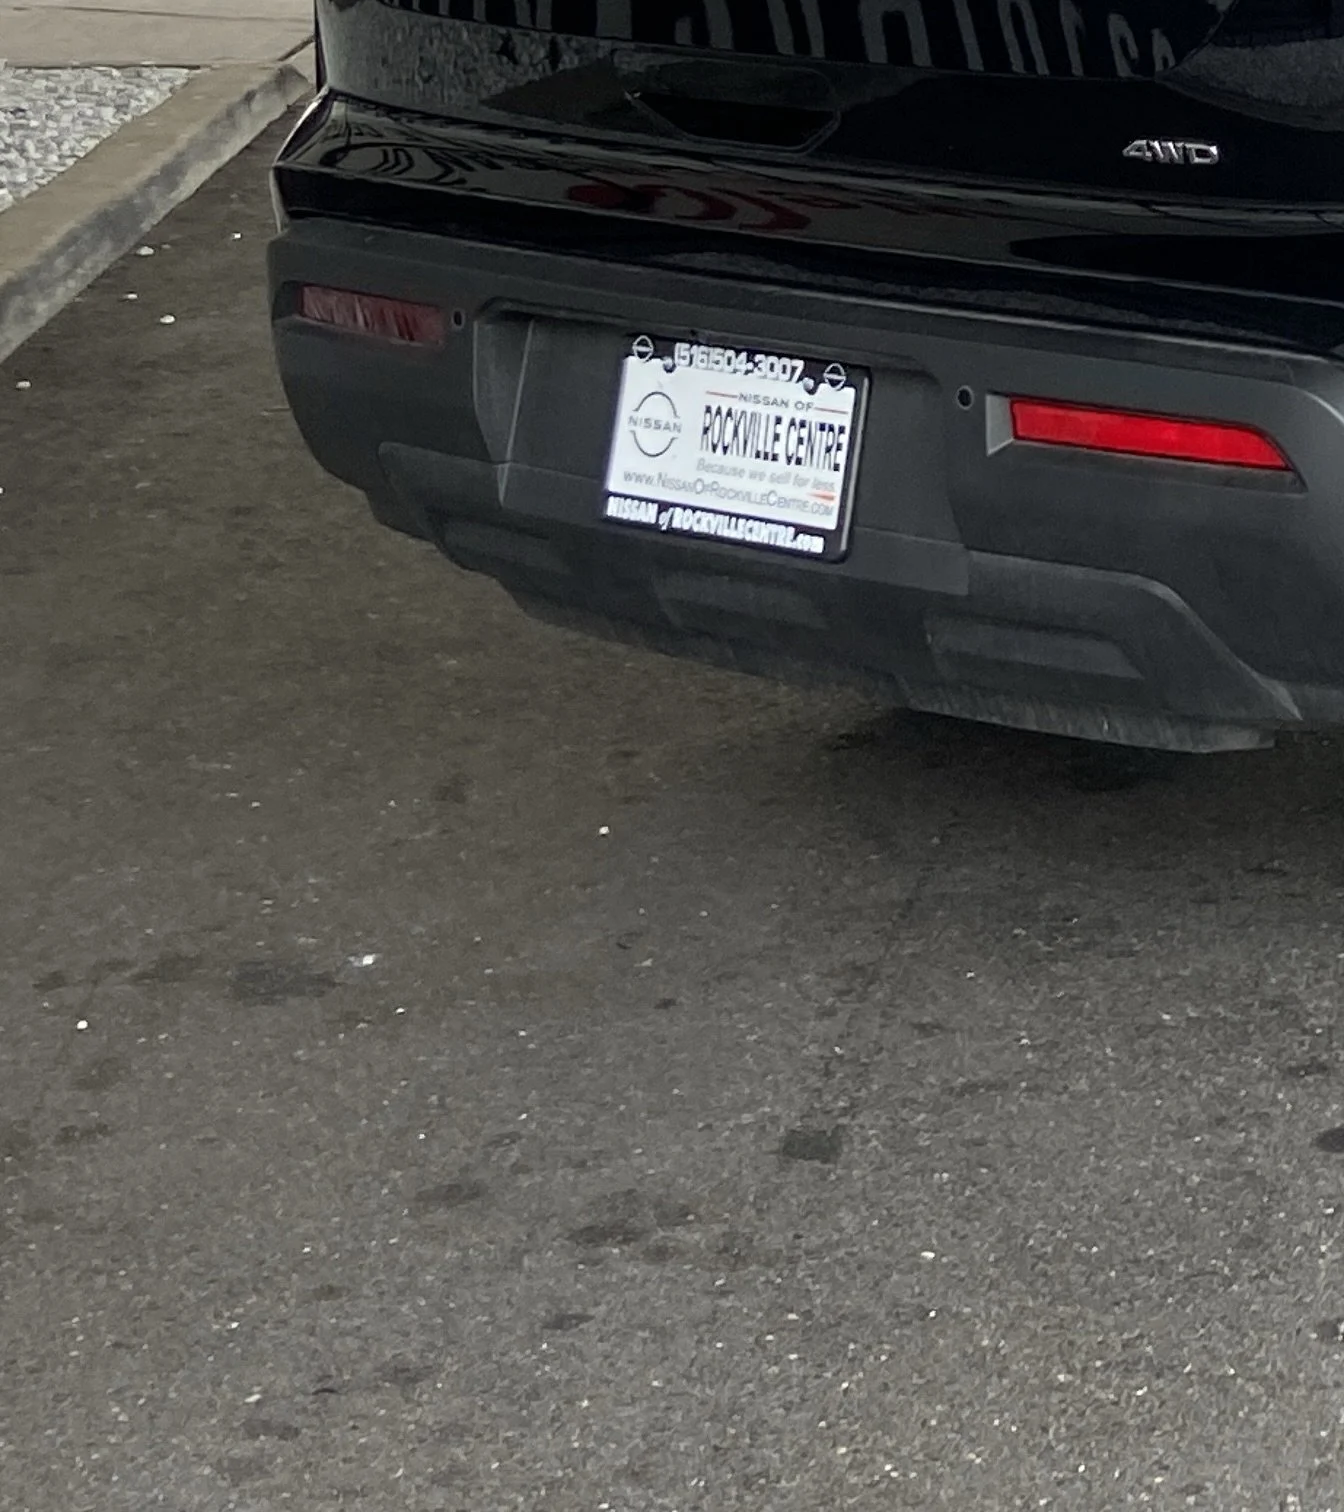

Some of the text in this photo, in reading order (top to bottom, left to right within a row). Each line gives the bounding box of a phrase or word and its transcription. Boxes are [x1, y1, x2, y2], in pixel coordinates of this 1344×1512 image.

[1122, 138, 1220, 166] 4WD
[737, 392, 815, 411] NISSAN OF
[627, 415, 683, 434] NISSAN
[700, 404, 847, 472] ROCKVILLE CENTRE
[696, 458, 746, 478] Because
[748, 468, 768, 481] we
[792, 471, 811, 487] for
[606, 495, 658, 523] NISSAN
[658, 508, 672, 532] of
